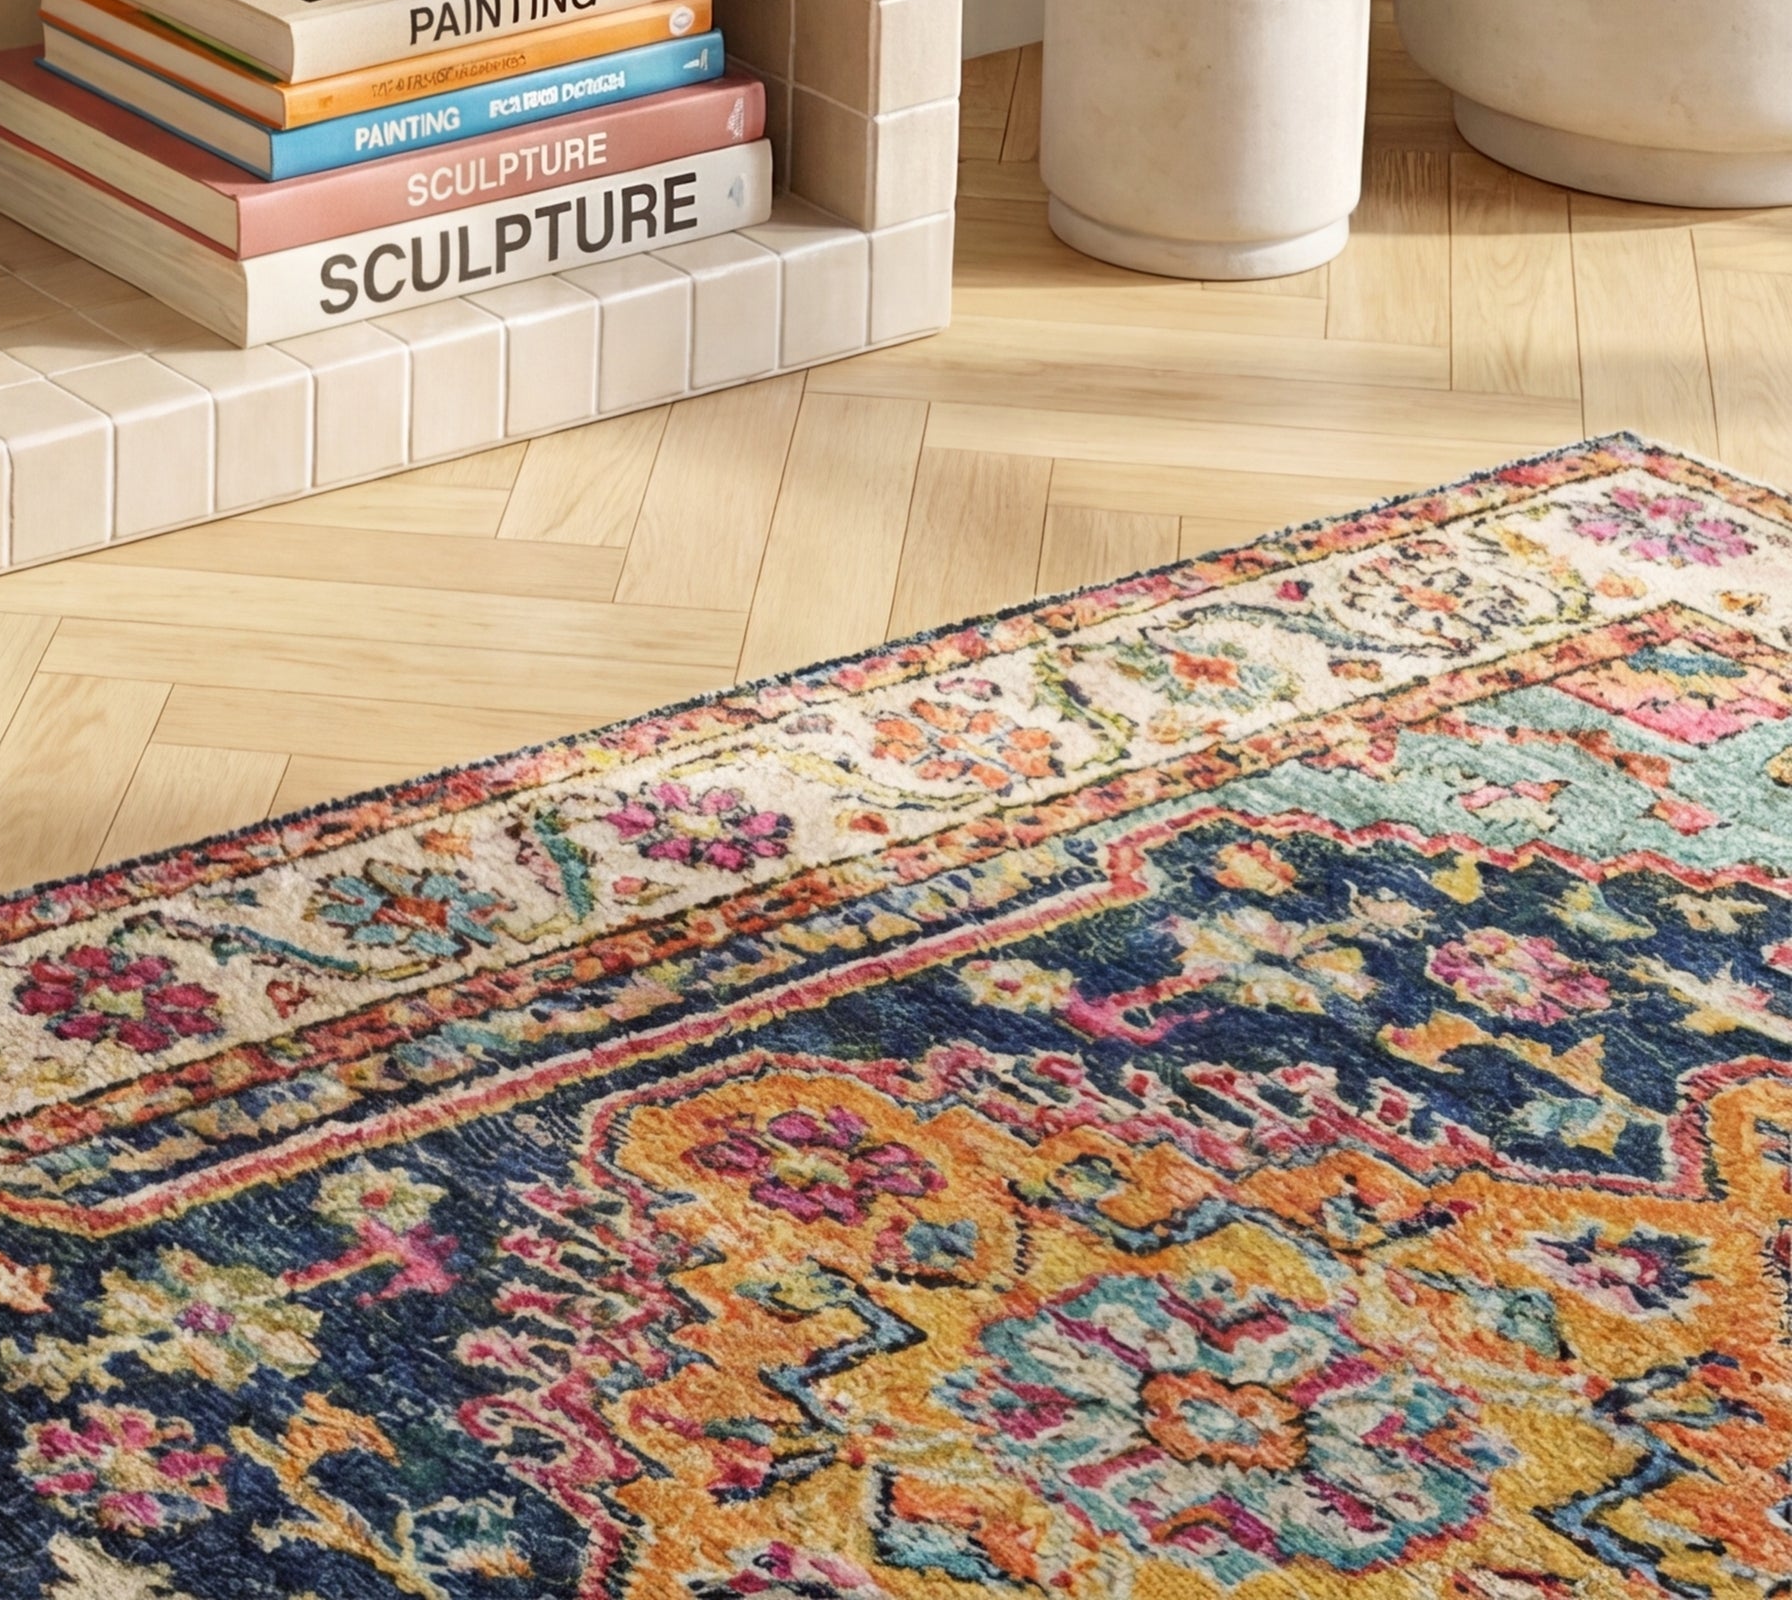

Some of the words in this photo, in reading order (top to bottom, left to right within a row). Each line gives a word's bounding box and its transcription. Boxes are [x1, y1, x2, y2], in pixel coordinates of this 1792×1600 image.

[355, 106, 461, 152] PAINTING
[407, 131, 608, 207] SCULPTURE
[319, 172, 698, 315] SCULPTURE
